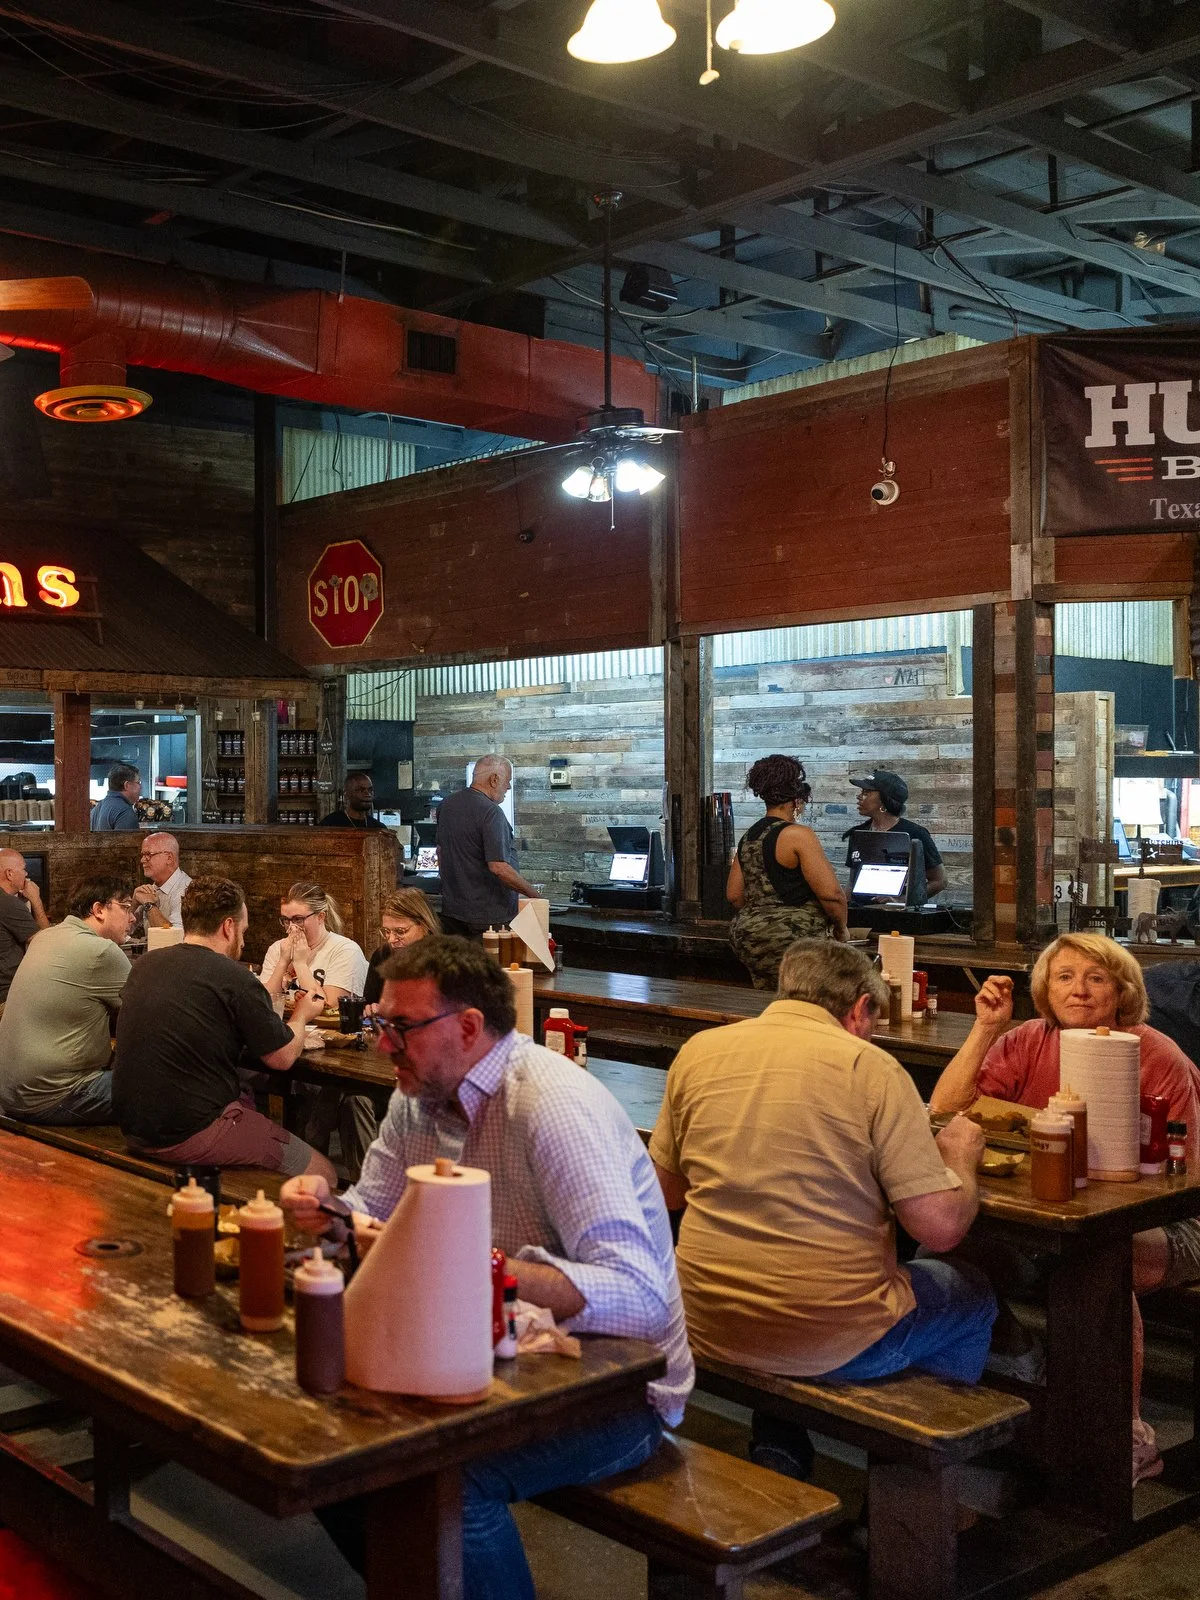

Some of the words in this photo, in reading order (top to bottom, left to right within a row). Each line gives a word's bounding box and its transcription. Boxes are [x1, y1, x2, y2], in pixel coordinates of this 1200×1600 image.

[1084, 380, 1200, 448] HU
[314, 572, 379, 617] STOP
[1055, 884, 1062, 899] 3
